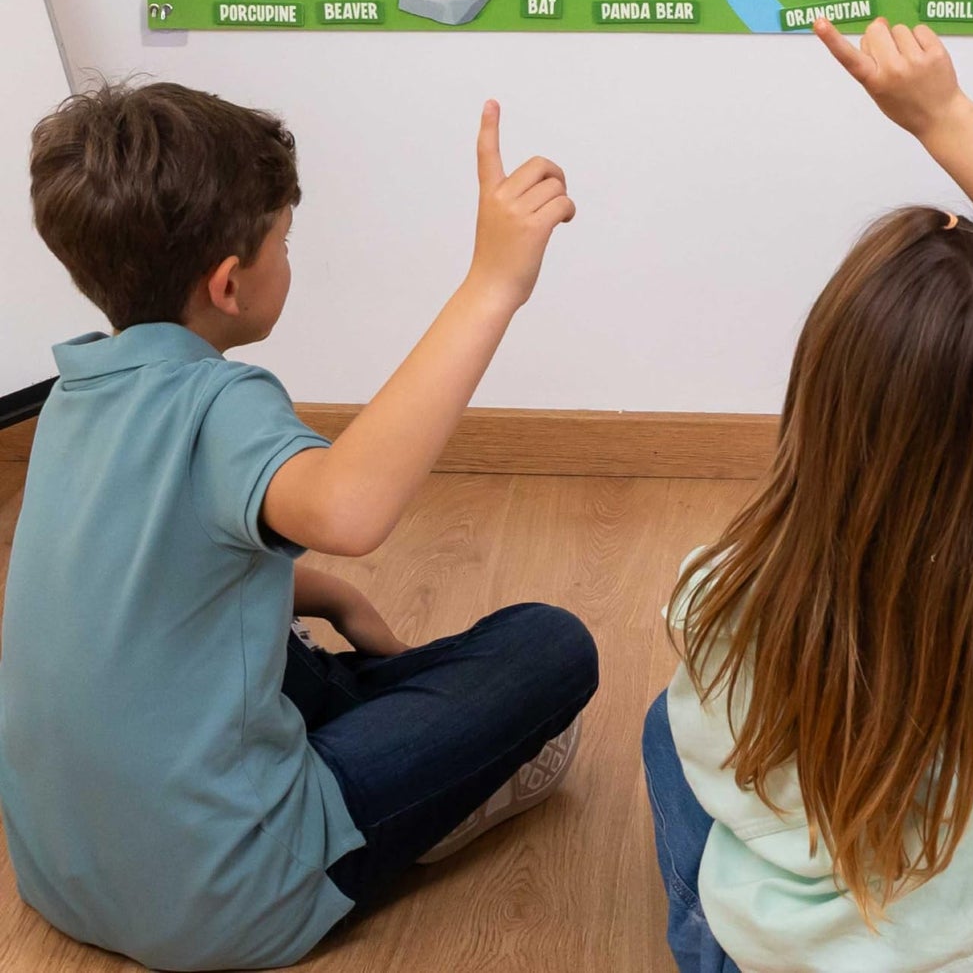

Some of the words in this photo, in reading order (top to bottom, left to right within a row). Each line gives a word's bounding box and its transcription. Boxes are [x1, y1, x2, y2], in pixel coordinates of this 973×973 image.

[220, 5, 296, 22] PORCUPINE
[325, 3, 377, 19] BEAVER
[602, 3, 650, 19] PANDA
[656, 3, 693, 19] BEAR
[785, 1, 871, 27] ORANGUTAN
